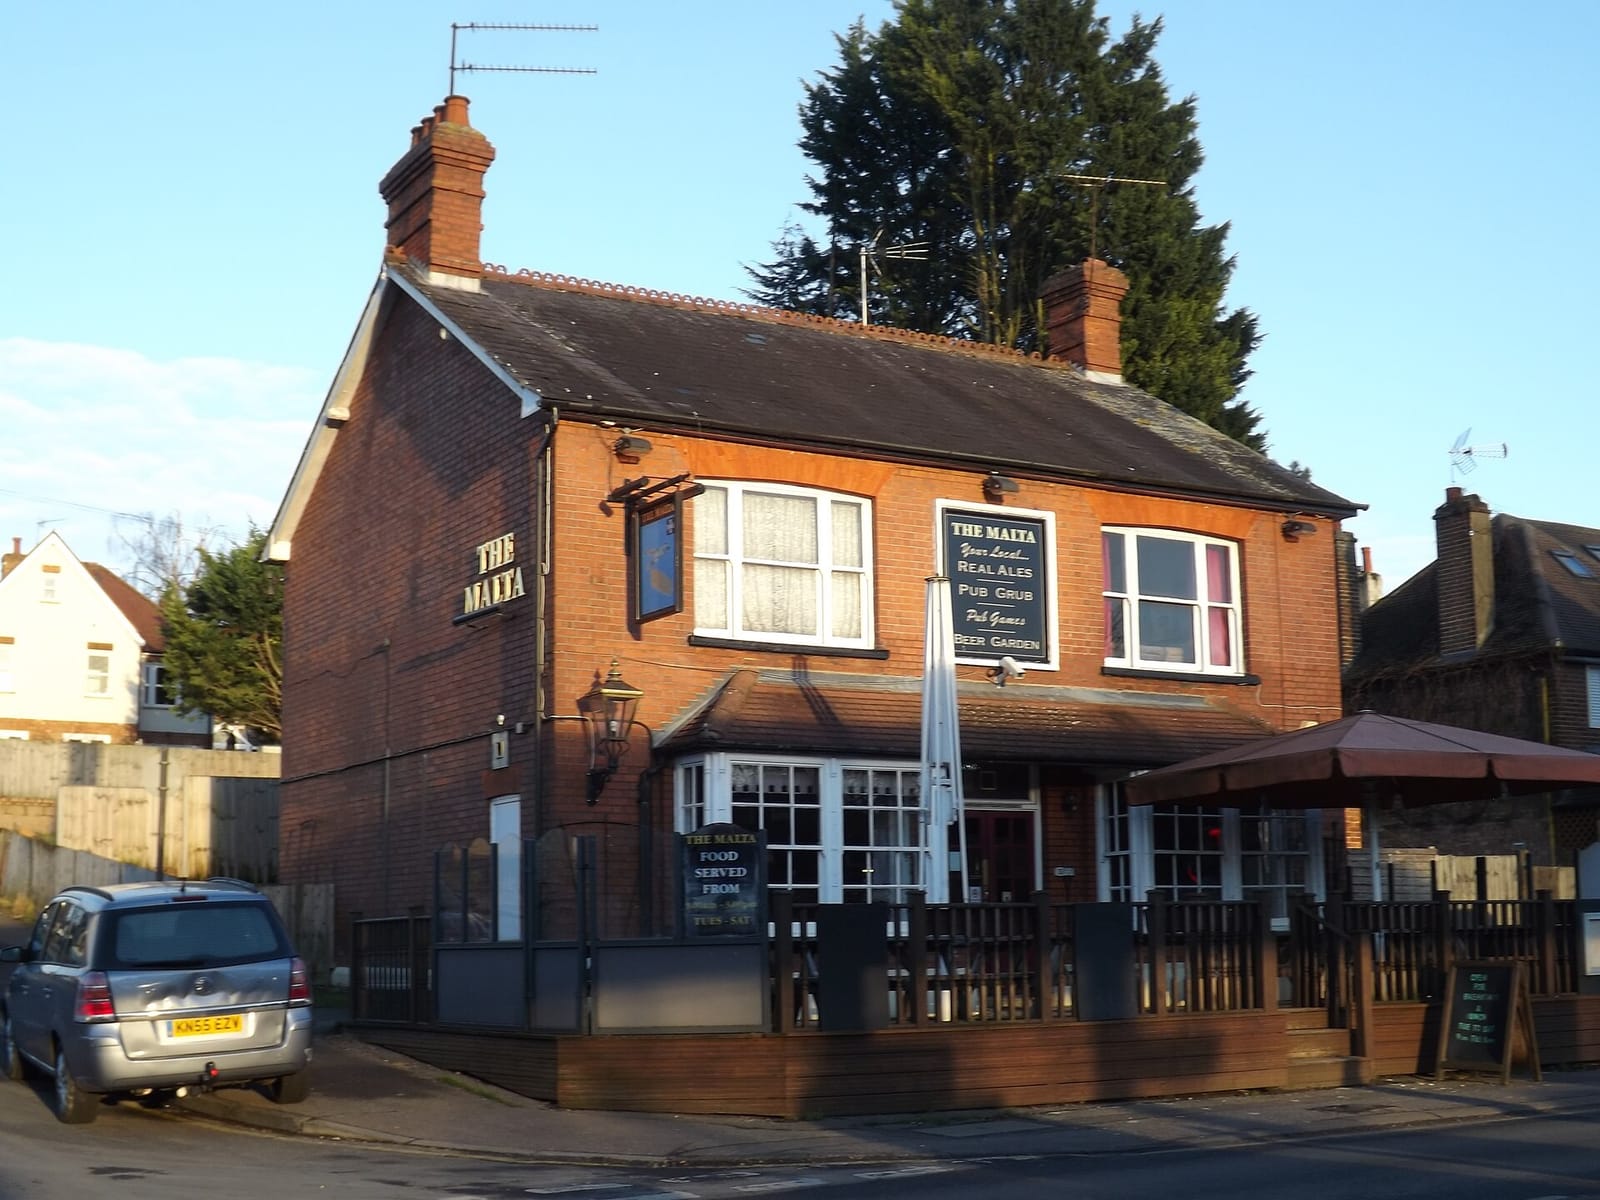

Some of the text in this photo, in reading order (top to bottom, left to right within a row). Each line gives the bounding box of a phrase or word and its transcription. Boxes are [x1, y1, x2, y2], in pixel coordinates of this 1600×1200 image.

[951, 522, 1036, 543] THE MALTA
[476, 532, 515, 575] THE
[960, 542, 988, 557] Your
[957, 561, 1033, 578] REAL ALES
[464, 566, 527, 614] MALTA
[958, 583, 1034, 601] PUB GRUB
[966, 609, 1026, 627] Pub Games
[953, 633, 1040, 650] BEER GARDEN
[686, 834, 756, 845] THE MALTA
[700, 851, 739, 862] FOOD
[694, 867, 747, 878] SERVED
[703, 883, 740, 894] FROM
